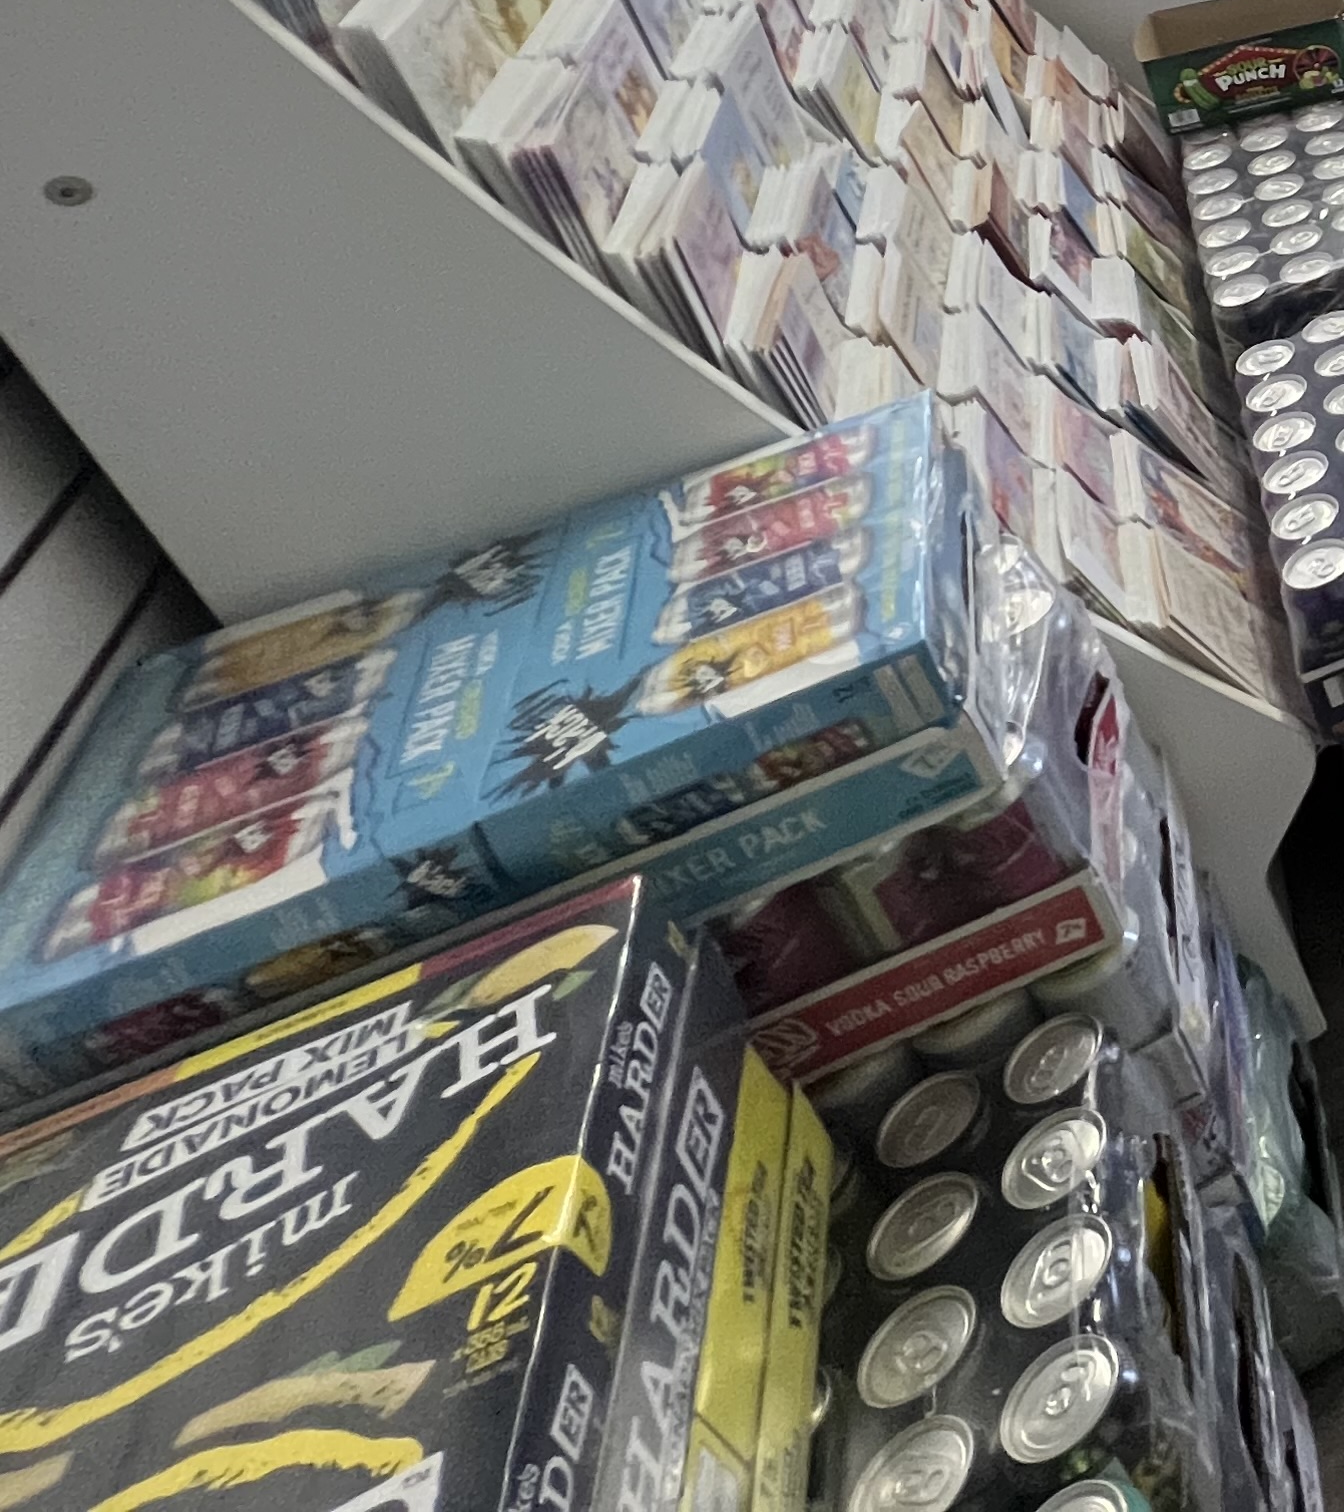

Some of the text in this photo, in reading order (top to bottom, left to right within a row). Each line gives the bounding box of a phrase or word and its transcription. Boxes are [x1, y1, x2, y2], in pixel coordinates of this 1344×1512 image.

[1214, 64, 1286, 92] PUNCH
[739, 807, 828, 855] PACK
[826, 928, 1047, 1038] VODKA SOUR RASPBERRY
[94, 1032, 410, 1201] LEMONADE
[142, 1007, 404, 1136] MIX PACK
[65, 1171, 359, 1364] mike's
[466, 1262, 538, 1331] 12
